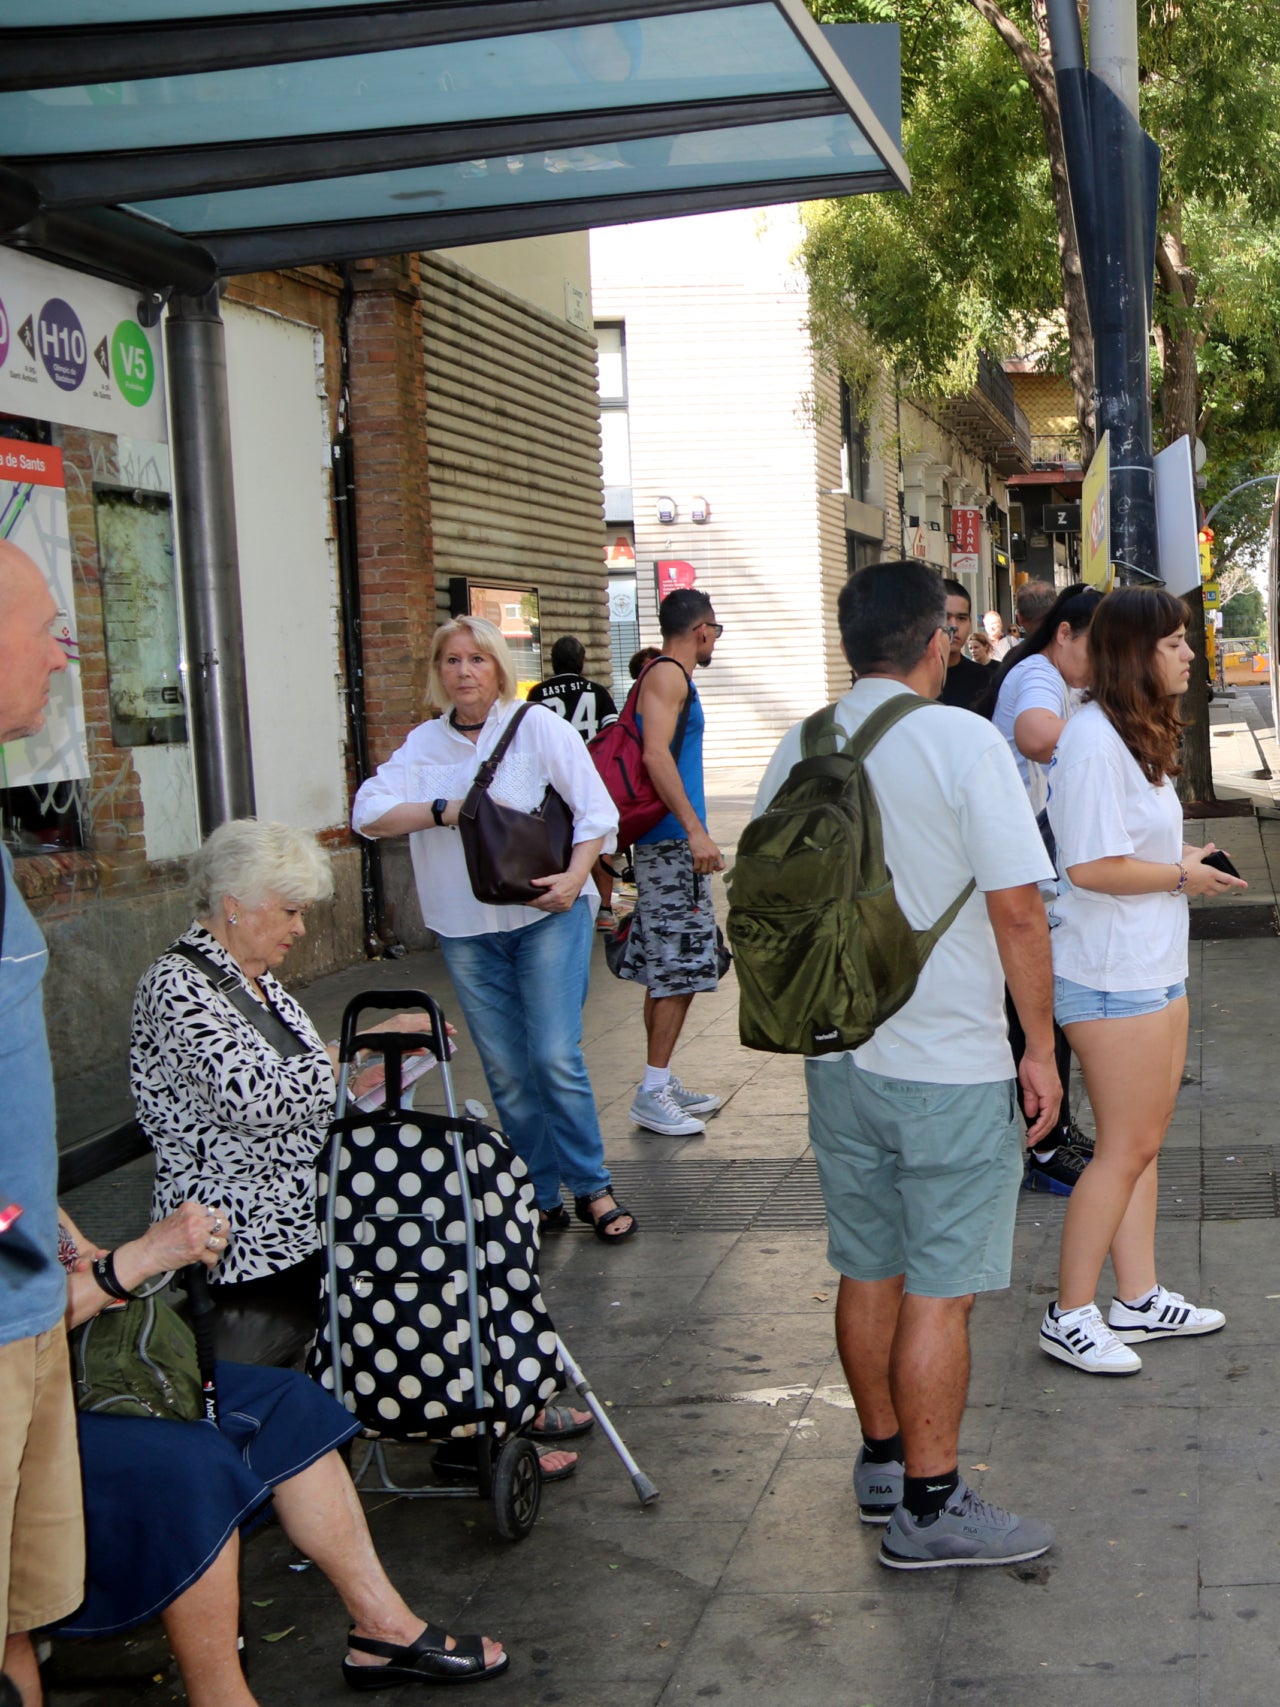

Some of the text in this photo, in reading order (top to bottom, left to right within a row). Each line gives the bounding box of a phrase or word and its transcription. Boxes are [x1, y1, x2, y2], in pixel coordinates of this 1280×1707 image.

[40, 320, 85, 365] H10
[119, 342, 146, 380] V5
[6, 453, 18, 468] de
[19, 454, 46, 472] Sants
[966, 510, 975, 553] DIANA
[542, 684, 566, 697] EAST
[205, 1397, 217, 1421] And
[868, 1484, 893, 1494] FILA
[963, 1525, 978, 1534] FILA
